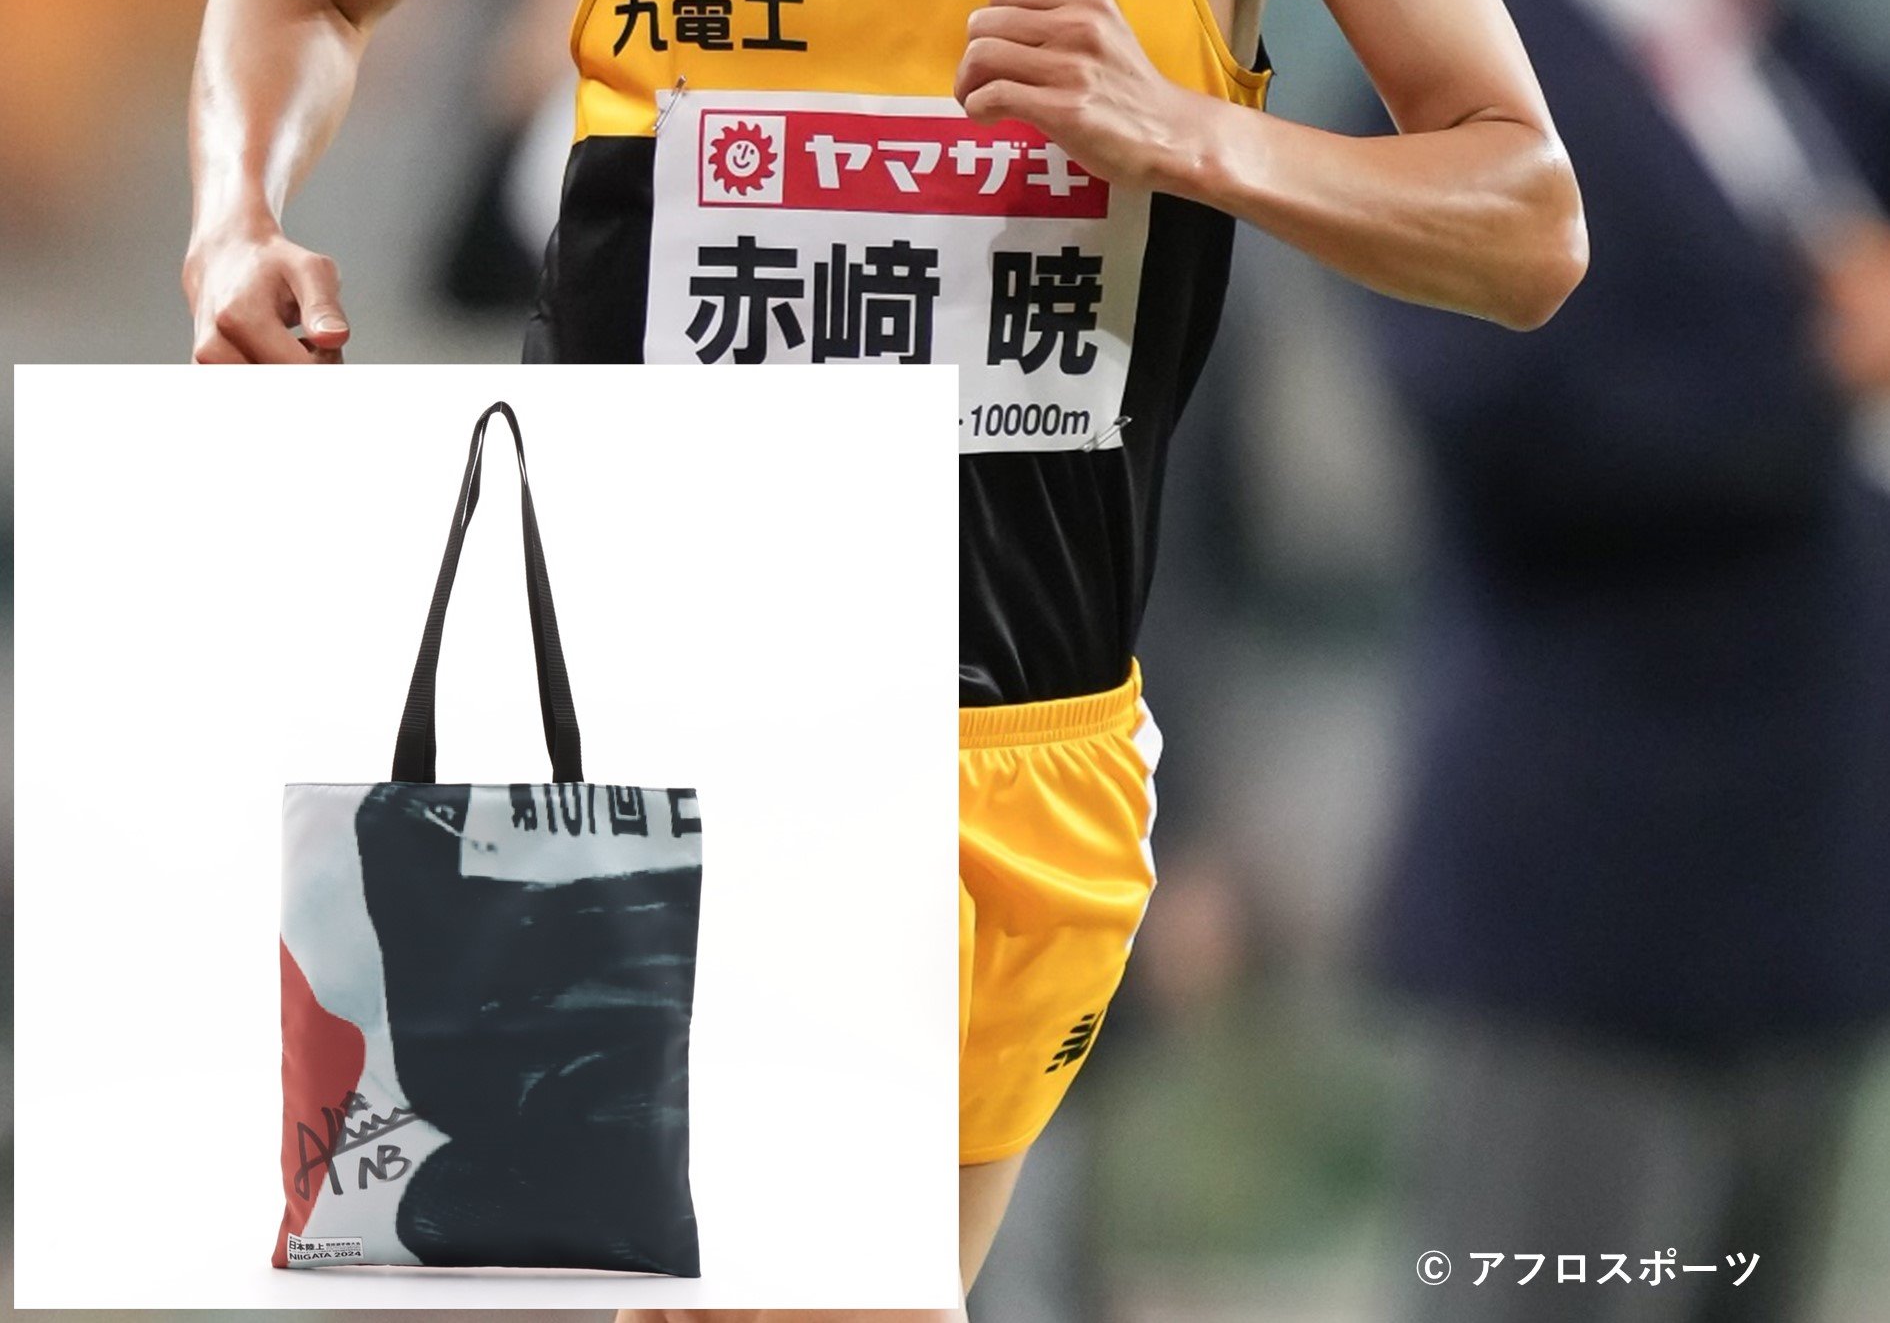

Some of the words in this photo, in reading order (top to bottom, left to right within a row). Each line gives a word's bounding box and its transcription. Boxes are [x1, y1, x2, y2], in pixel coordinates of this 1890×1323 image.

[805, 135, 1090, 197] ヤマザキ
[289, 1252, 332, 1260] NIIGATA
